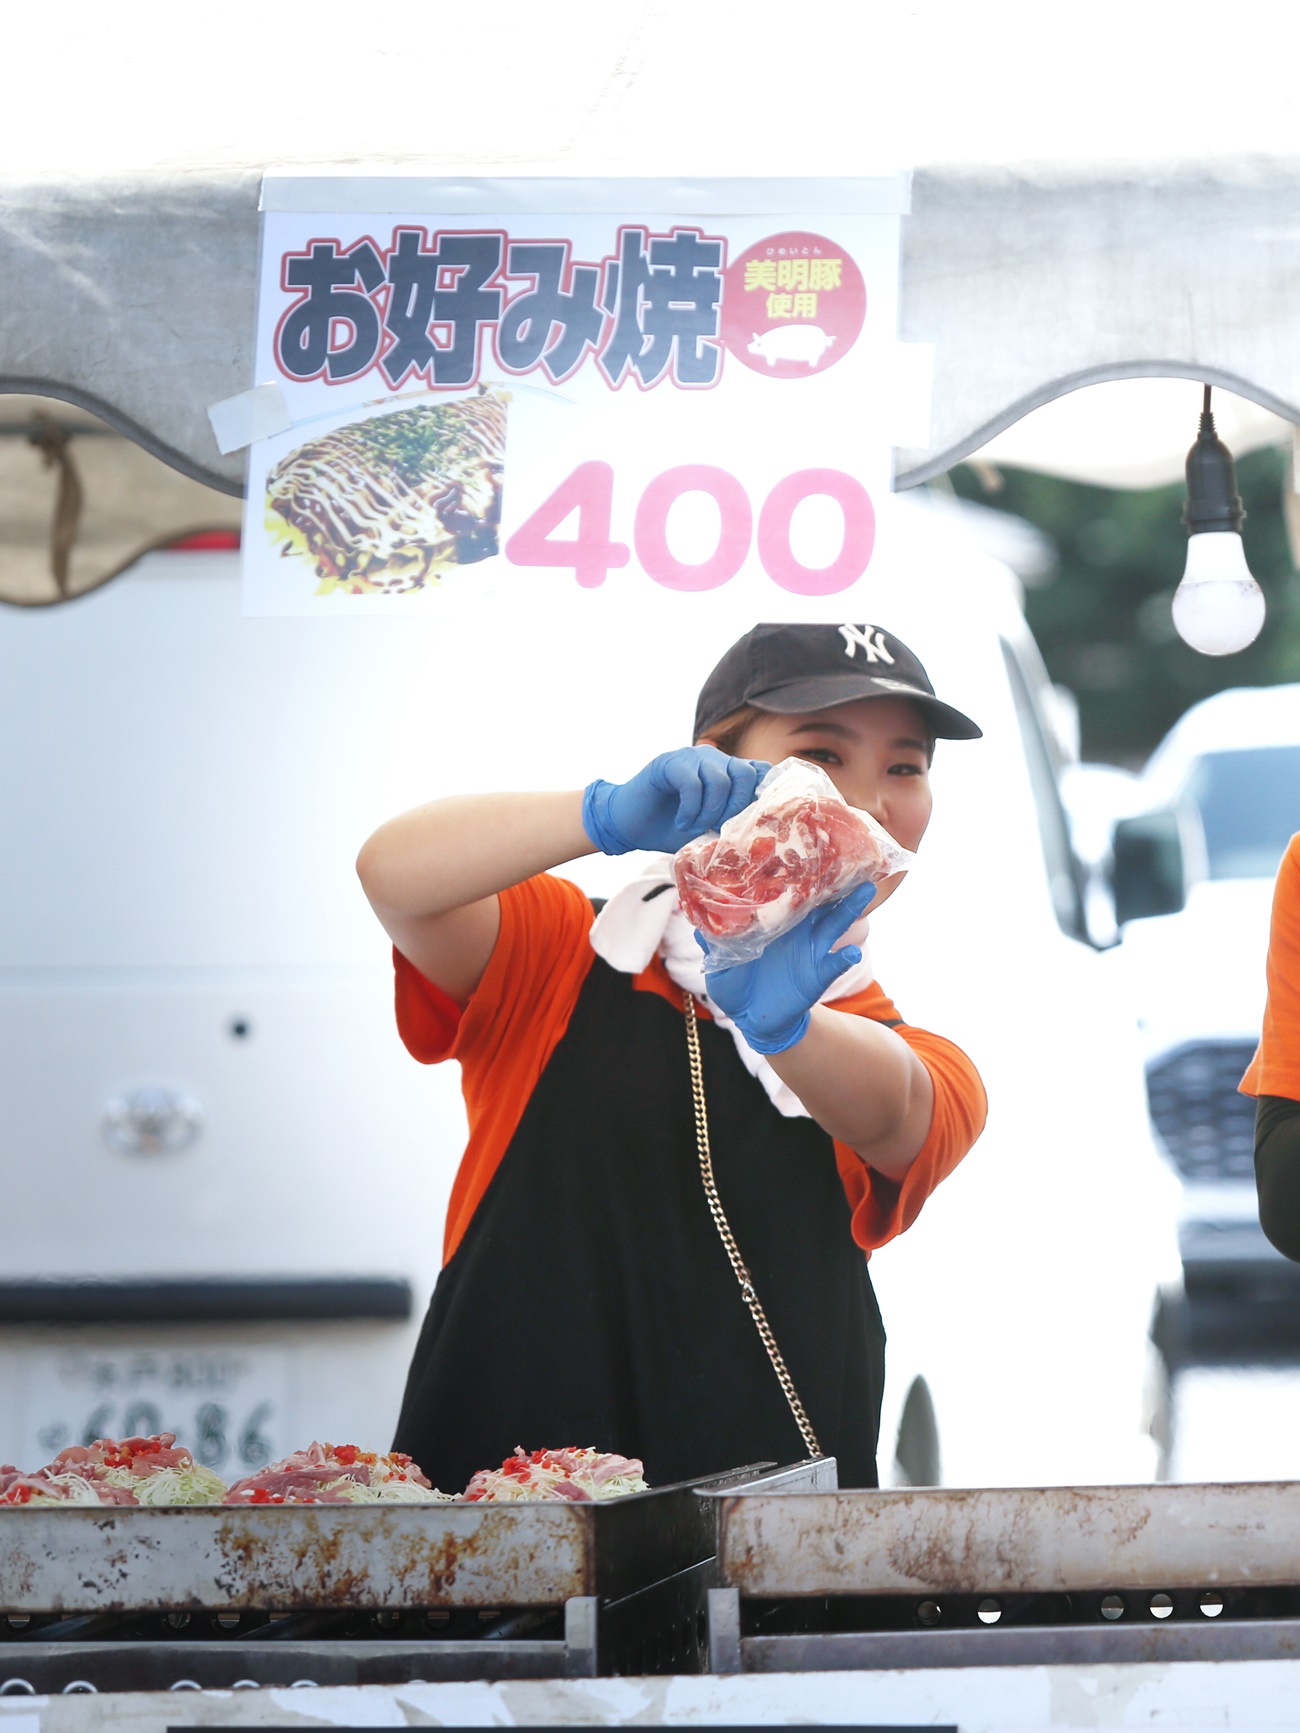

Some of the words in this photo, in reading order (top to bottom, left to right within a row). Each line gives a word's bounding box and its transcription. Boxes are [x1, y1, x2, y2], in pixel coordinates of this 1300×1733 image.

[276, 226, 727, 390] お好み焼
[744, 258, 842, 291] 美明豚
[765, 293, 818, 318] 使用
[505, 460, 876, 596] 400
